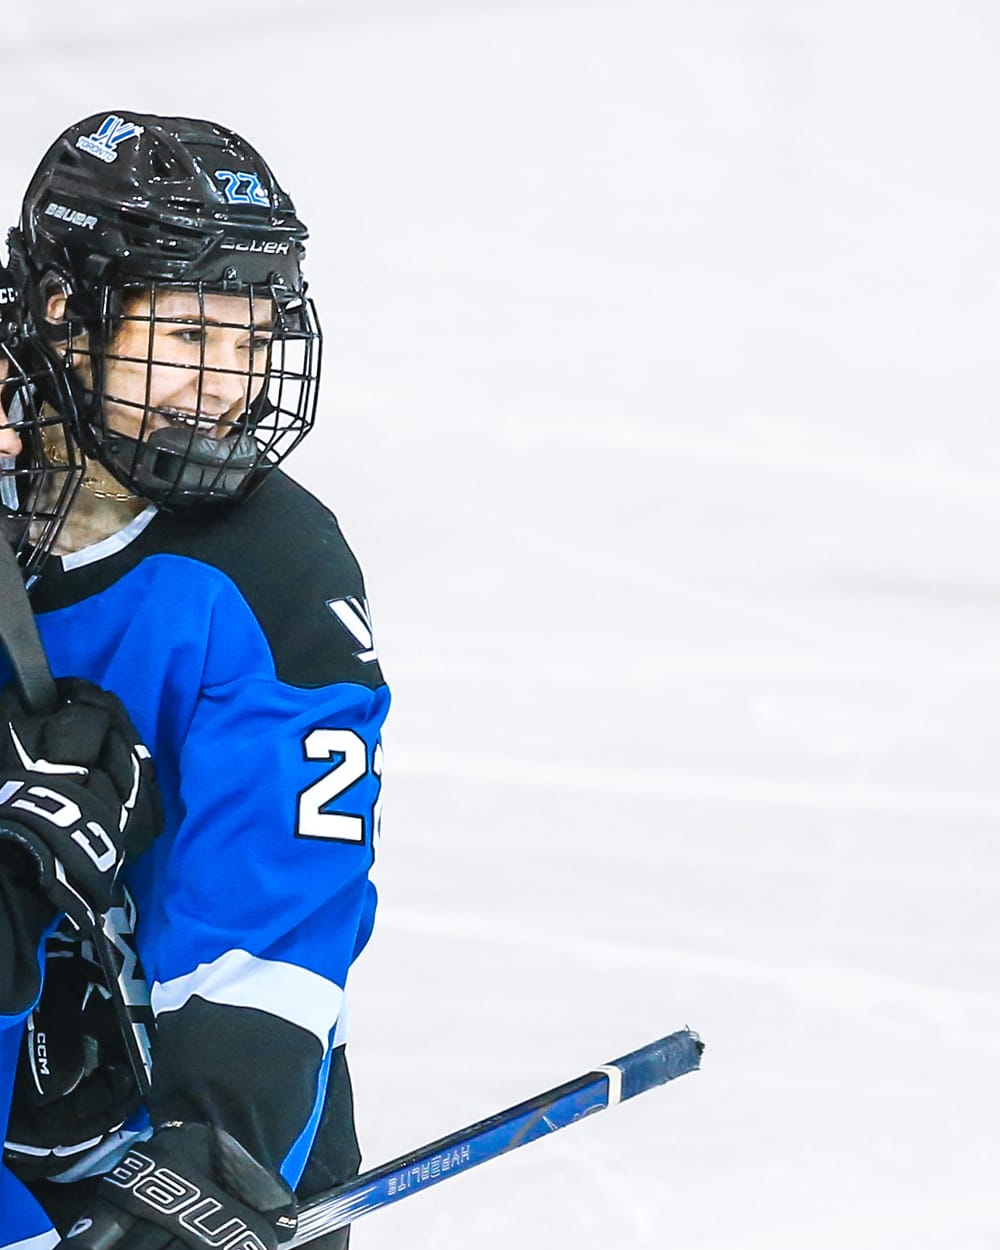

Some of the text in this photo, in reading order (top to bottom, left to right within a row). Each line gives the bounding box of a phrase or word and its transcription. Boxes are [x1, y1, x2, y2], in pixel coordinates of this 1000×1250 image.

[214, 170, 270, 207] 22
[44, 203, 98, 230] BAUER
[296, 728, 383, 845] 2
[36, 1032, 50, 1075] CCM
